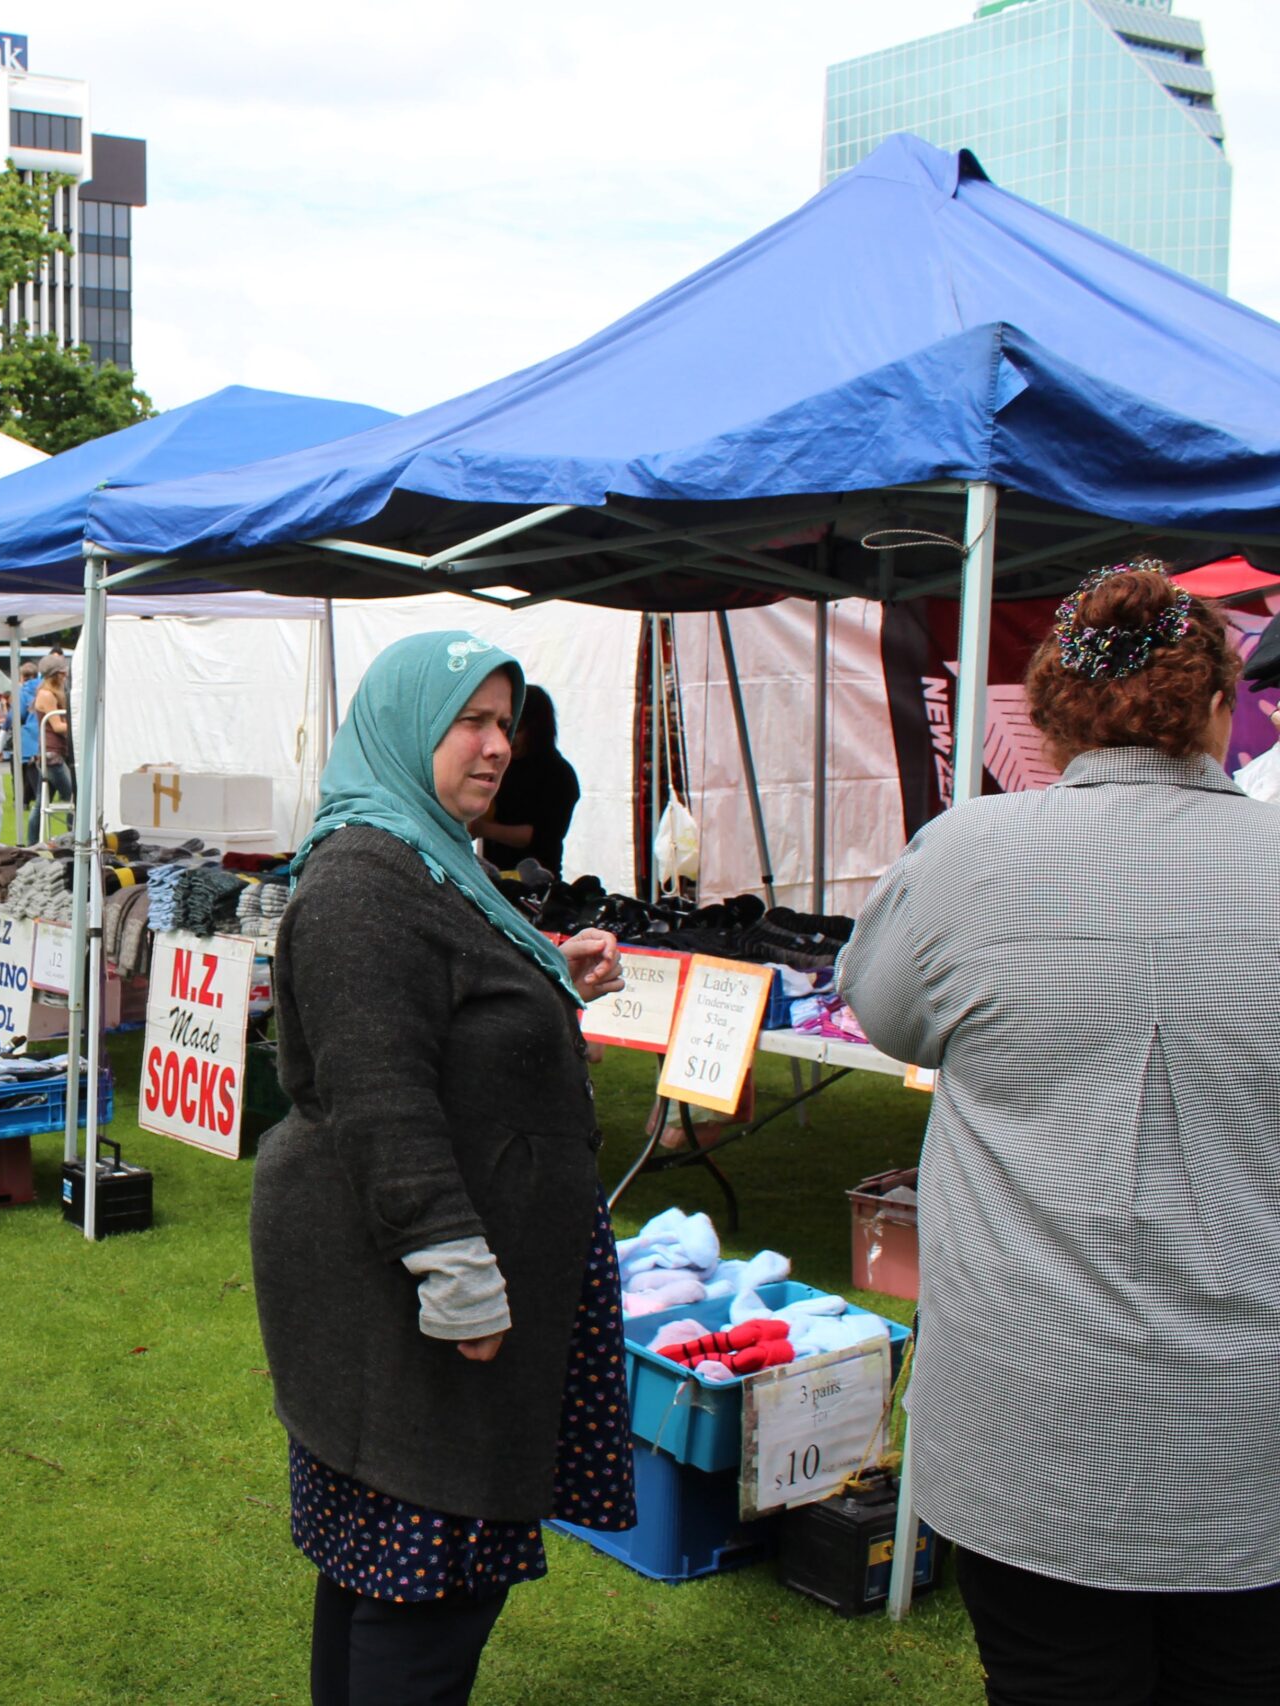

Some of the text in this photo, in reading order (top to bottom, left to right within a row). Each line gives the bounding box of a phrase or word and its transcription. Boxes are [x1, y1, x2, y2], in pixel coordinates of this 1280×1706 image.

[921, 676, 953, 755] NEW
[171, 948, 223, 1009] N.Z.
[621, 965, 665, 983] OXERS
[702, 973, 749, 998] Lady's
[612, 998, 643, 1020] $20
[697, 993, 745, 1013] Underwear
[169, 1006, 220, 1054] Made
[690, 1032, 730, 1052] or 4 for
[684, 1055, 721, 1083] $10
[145, 1046, 236, 1136] SOCKS
[800, 1380, 841, 1408] 3 pairs
